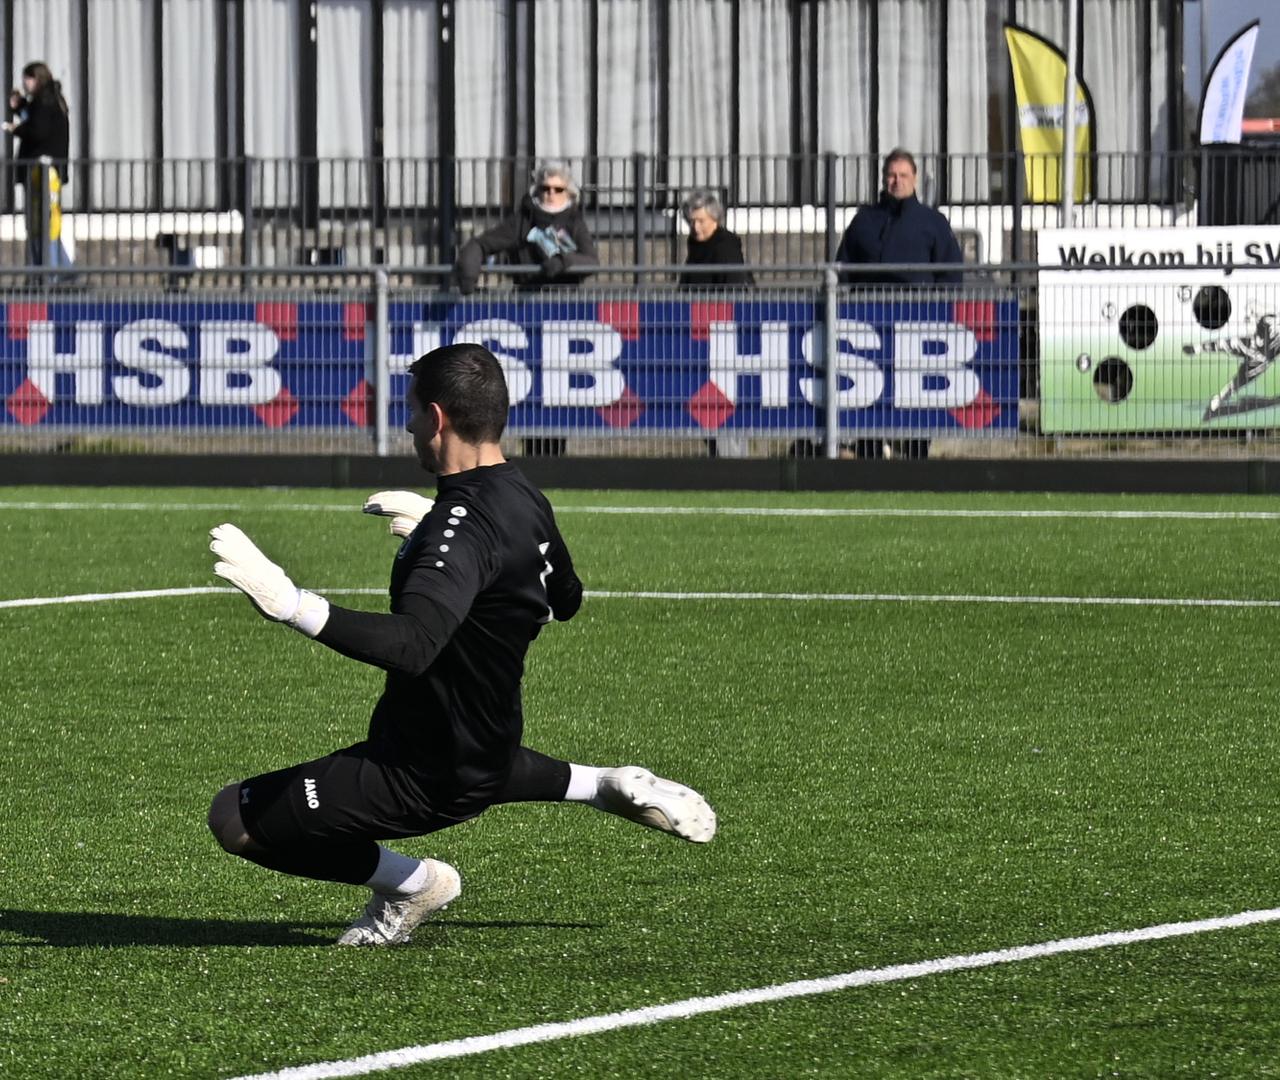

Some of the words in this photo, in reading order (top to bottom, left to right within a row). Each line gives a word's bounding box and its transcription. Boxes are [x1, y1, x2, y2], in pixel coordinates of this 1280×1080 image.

[1059, 244, 1185, 270] Welkom
[26, 318, 282, 408] HSB
[709, 318, 981, 409] HSB
[304, 778, 320, 809] JAKO
